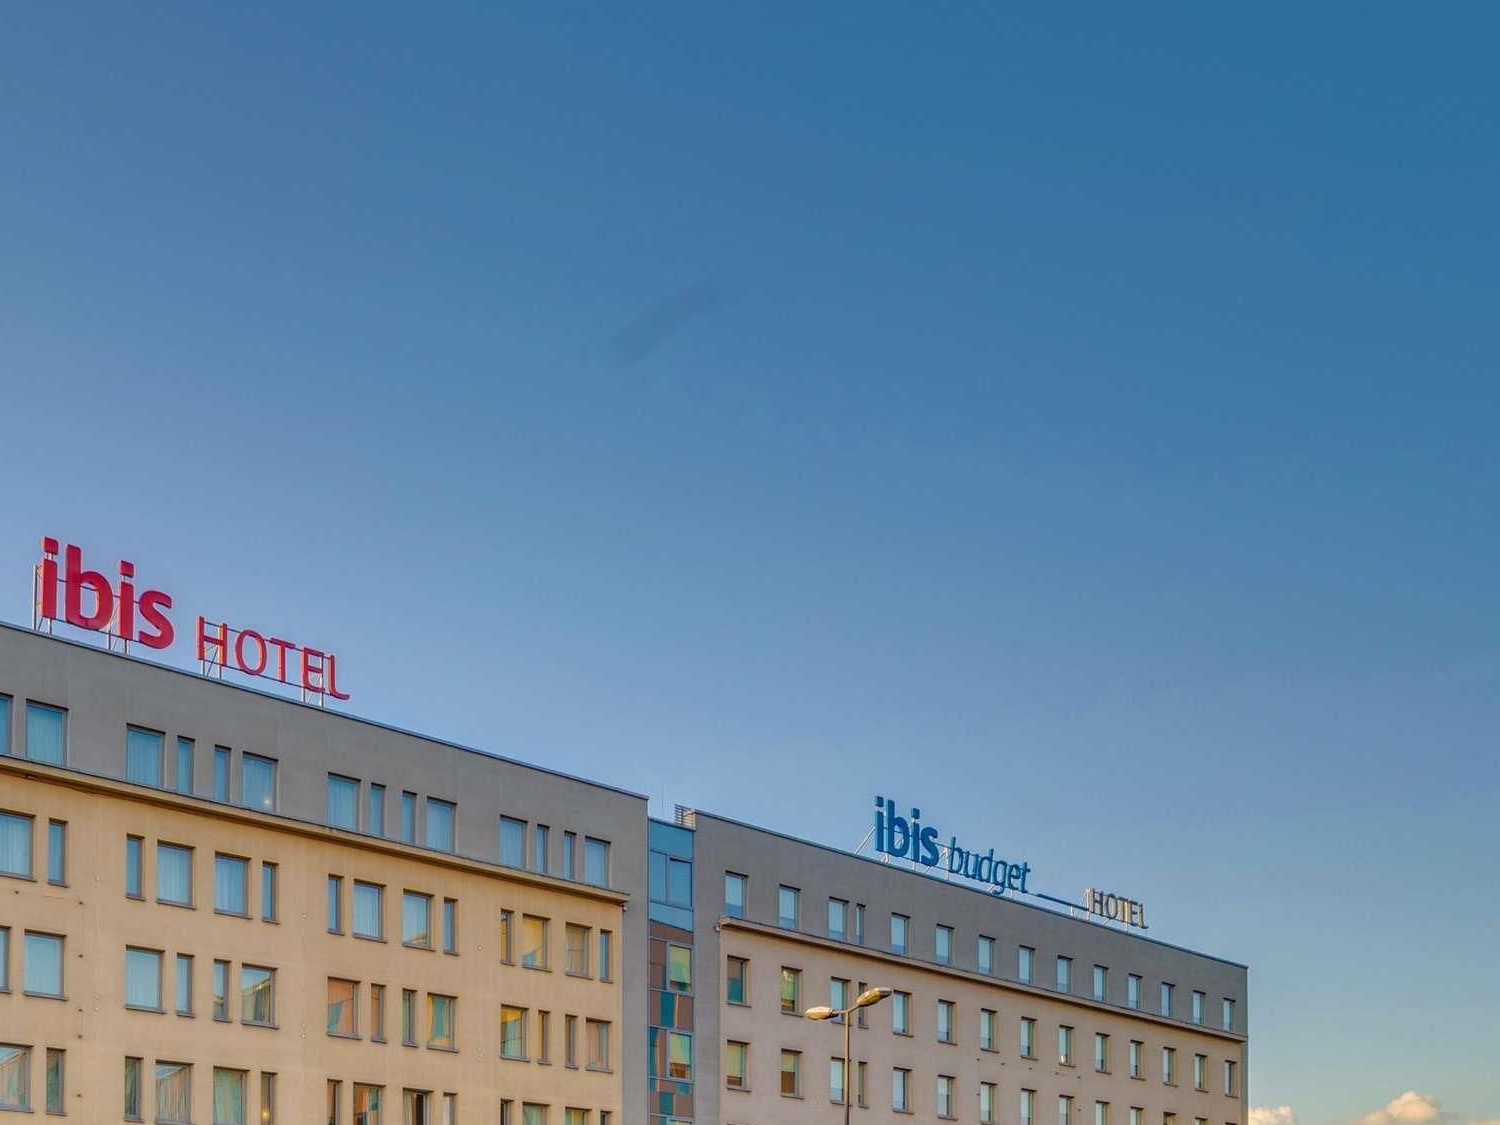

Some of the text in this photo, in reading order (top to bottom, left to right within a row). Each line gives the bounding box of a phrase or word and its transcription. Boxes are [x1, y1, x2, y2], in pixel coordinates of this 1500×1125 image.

[41, 536, 350, 700] ibis HOTEL
[874, 795, 1149, 929] ibis budget HOTEL
